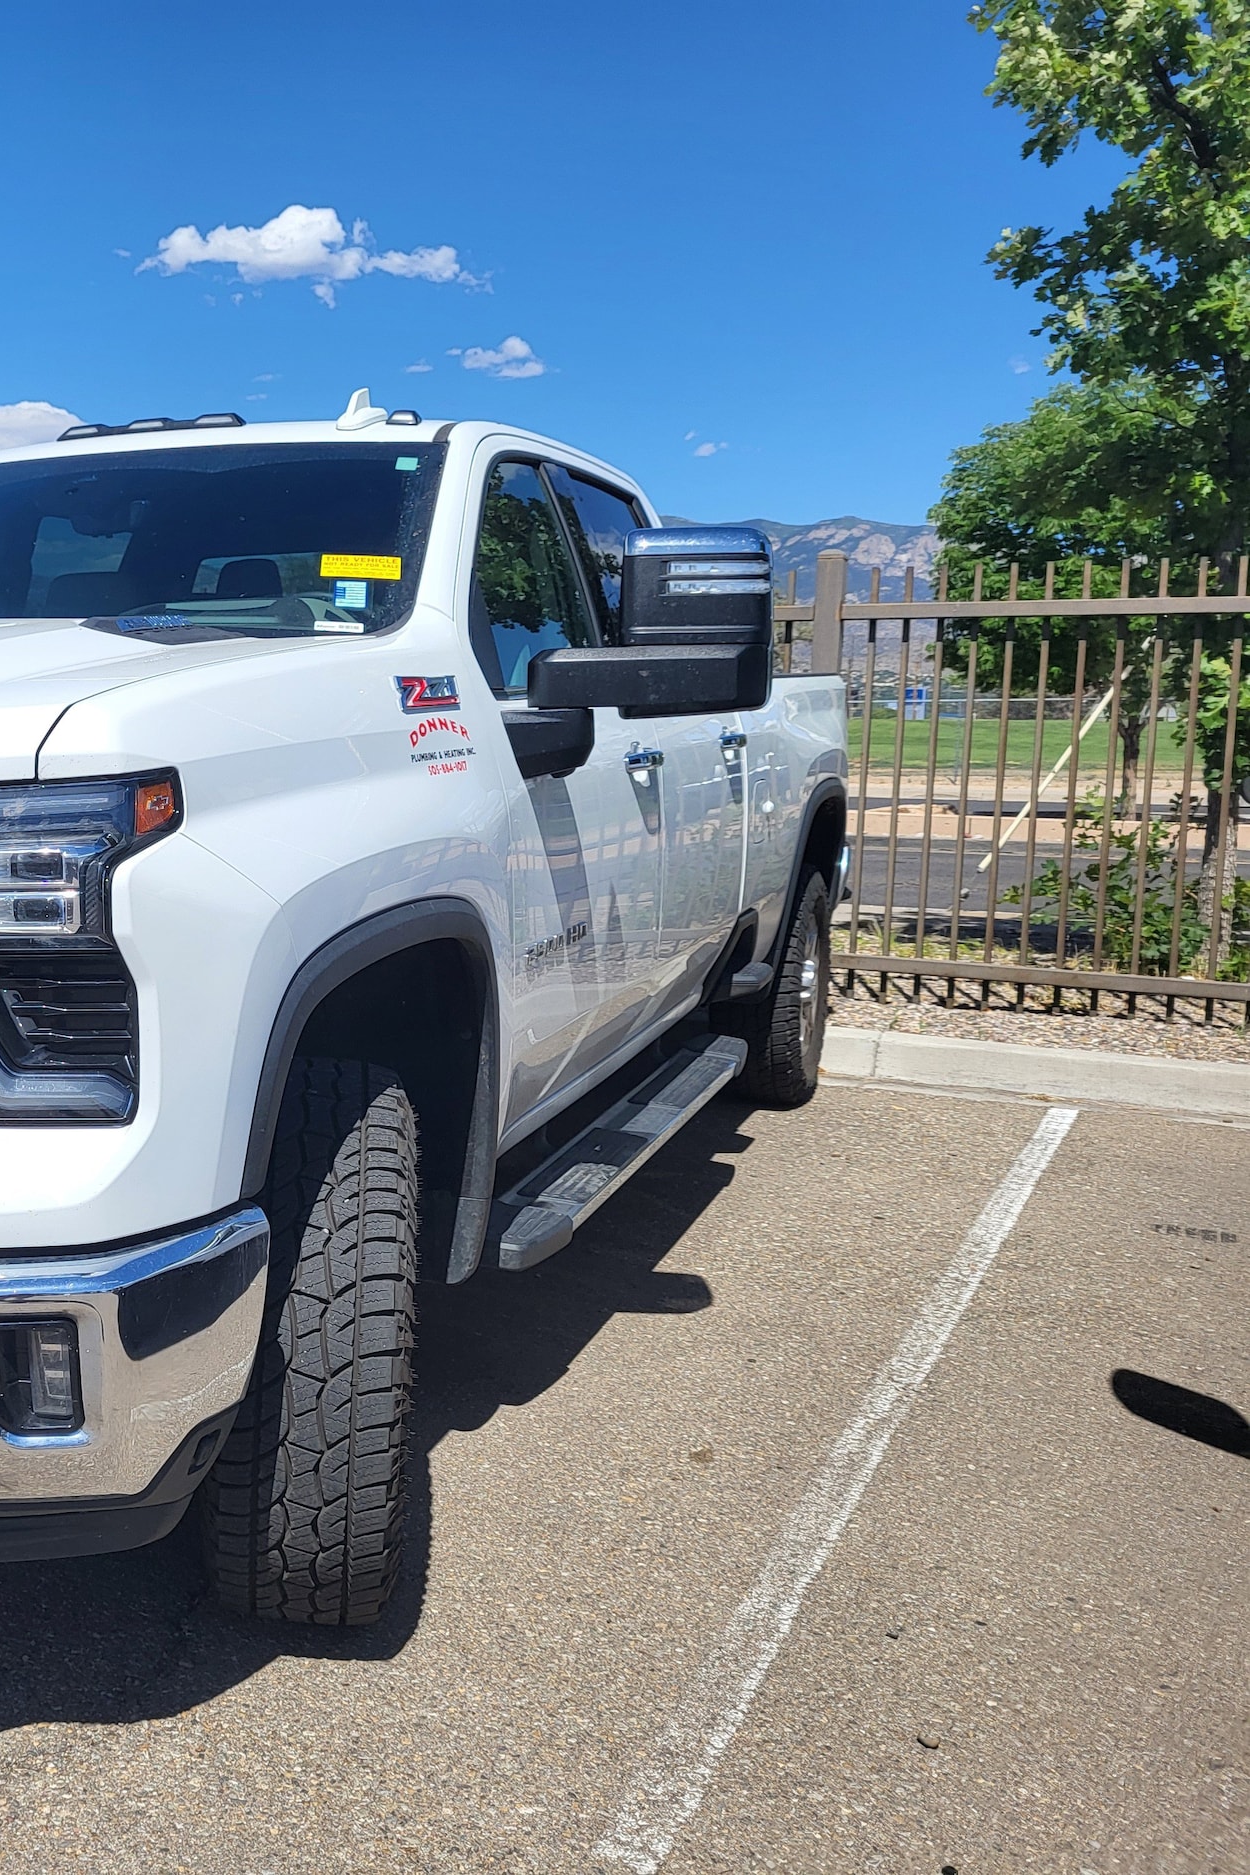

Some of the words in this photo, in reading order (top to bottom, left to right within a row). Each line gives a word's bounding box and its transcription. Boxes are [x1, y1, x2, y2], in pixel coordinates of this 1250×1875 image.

[409, 717, 471, 748] DONNER
[410, 751, 437, 763] PLUMBING
[443, 748, 465, 758] HEATING
